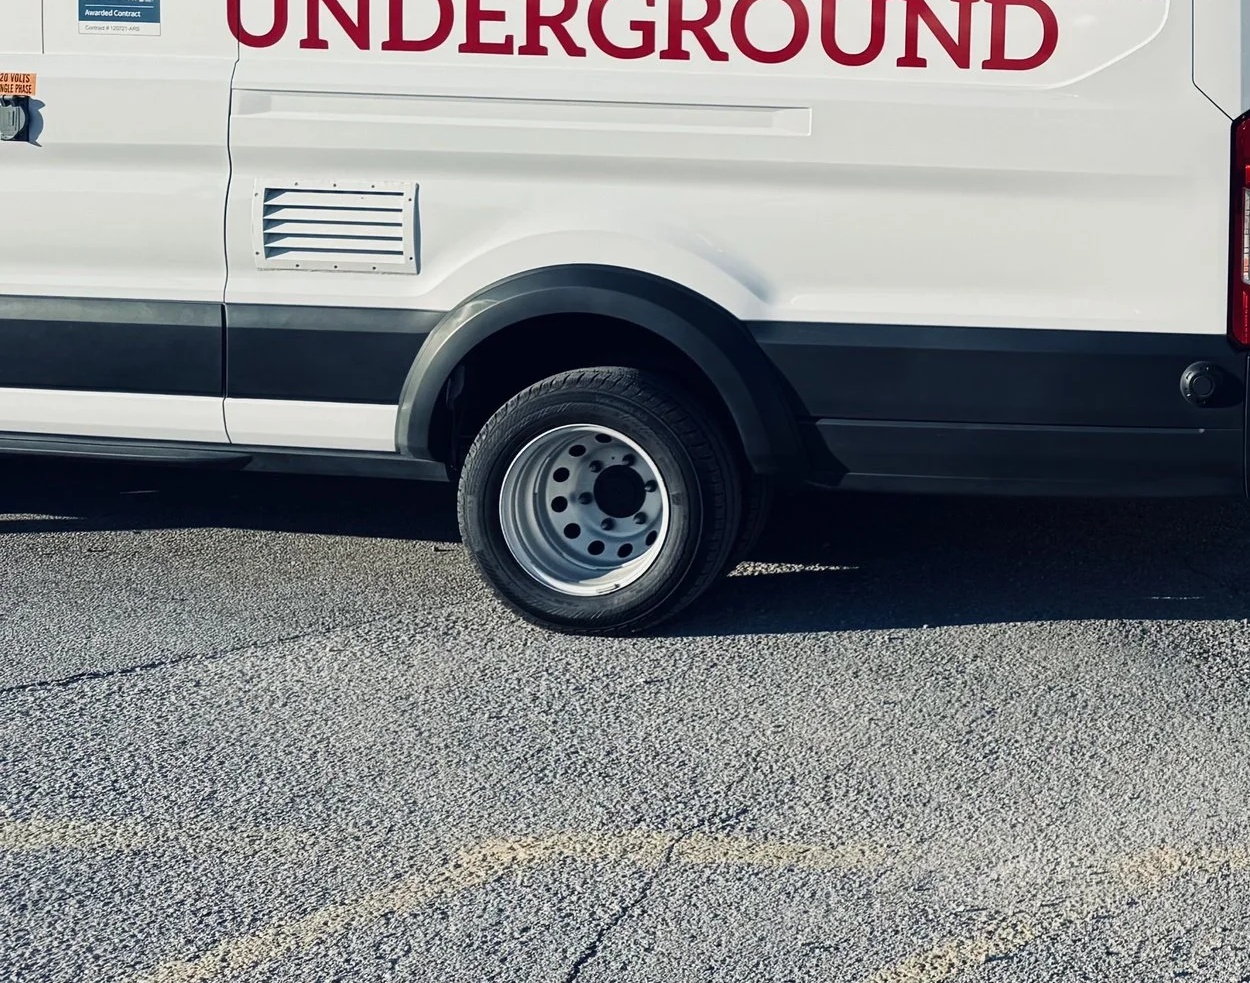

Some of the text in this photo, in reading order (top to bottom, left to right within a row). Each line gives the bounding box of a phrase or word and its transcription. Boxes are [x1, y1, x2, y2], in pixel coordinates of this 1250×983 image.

[84, 9, 141, 18] Awarded Contract
[10, 72, 31, 84] VOLTS
[15, 84, 32, 94] PHASE
